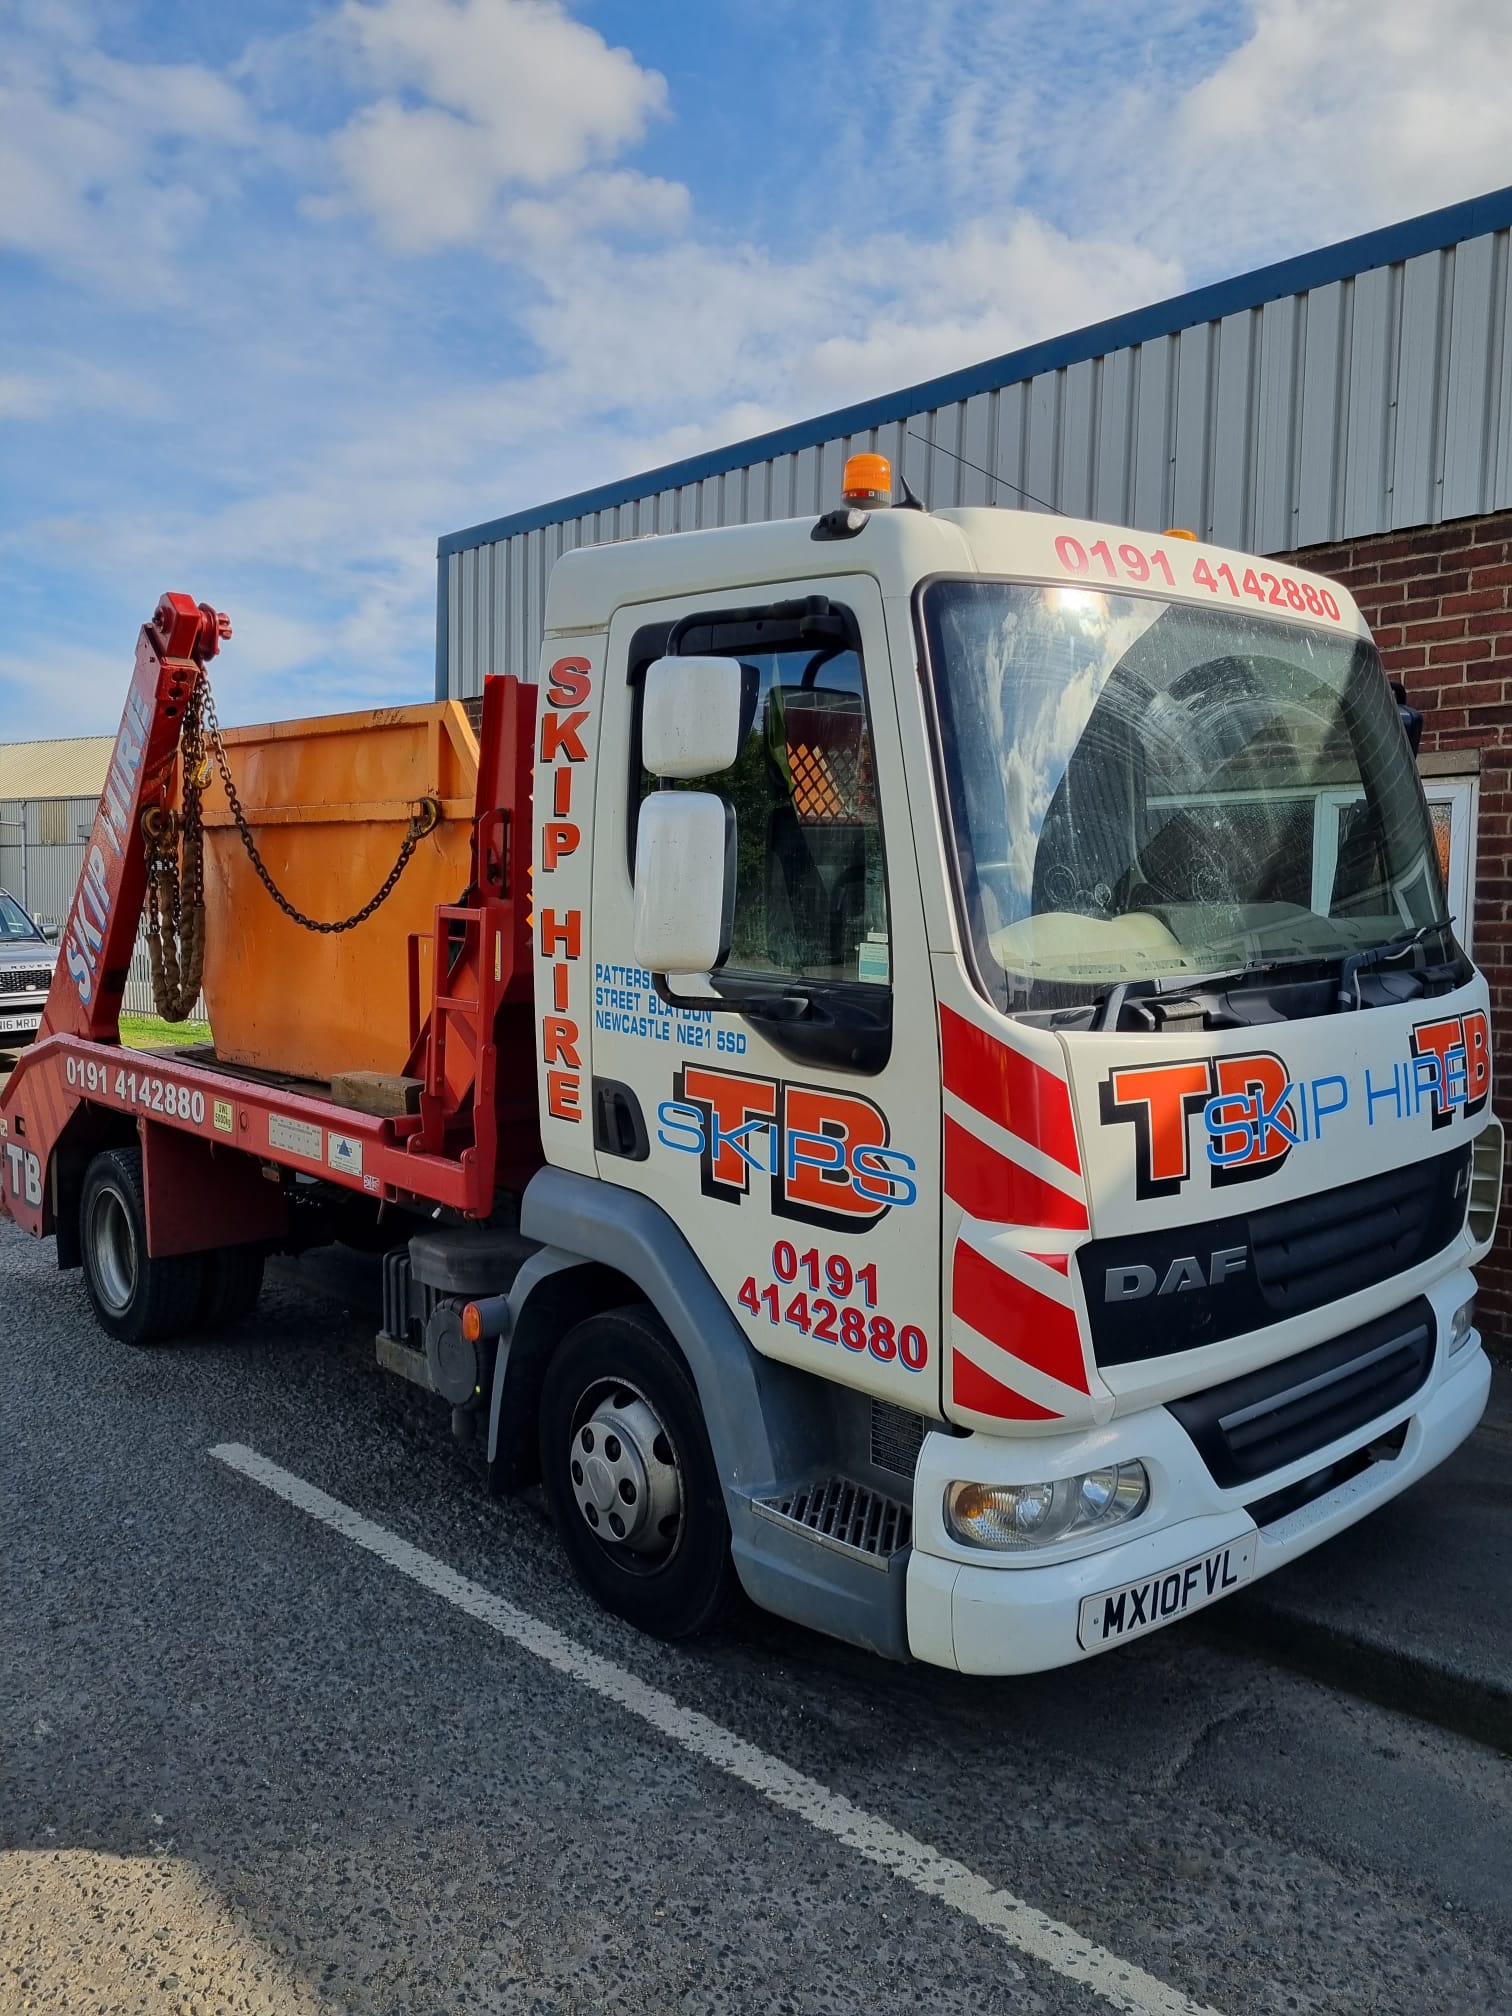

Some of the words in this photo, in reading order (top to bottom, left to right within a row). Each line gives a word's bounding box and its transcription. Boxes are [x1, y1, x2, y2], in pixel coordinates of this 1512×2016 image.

[1054, 535, 1176, 586] 0191
[1192, 558, 1341, 622] 4142880
[540, 656, 592, 878] SKIP
[66, 844, 110, 1006] SKIP
[540, 908, 583, 1124] HIRE
[595, 963, 670, 990] PATTERS
[595, 986, 641, 1012] STREET
[16, 1018, 37, 1028] MRD
[595, 1009, 670, 1042] NEWCASTLE
[676, 1023, 712, 1049] NE21
[716, 1030, 747, 1055] 5SD
[66, 1056, 108, 1096] 0191
[114, 1070, 205, 1124] 4142880
[1098, 1050, 1298, 1202] TB
[1408, 1007, 1491, 1132] TB
[1203, 1074, 1350, 1168] SKIP
[1364, 1047, 1468, 1126] HIRE
[6, 1142, 42, 1210] TB
[656, 1100, 918, 1207] SKIPS
[672, 1060, 898, 1235] TB
[771, 1239, 878, 1309] 0191
[1104, 1245, 1248, 1303] DAF
[736, 1275, 929, 1373] 4142880
[1102, 1549, 1238, 1639] MX10FVL
